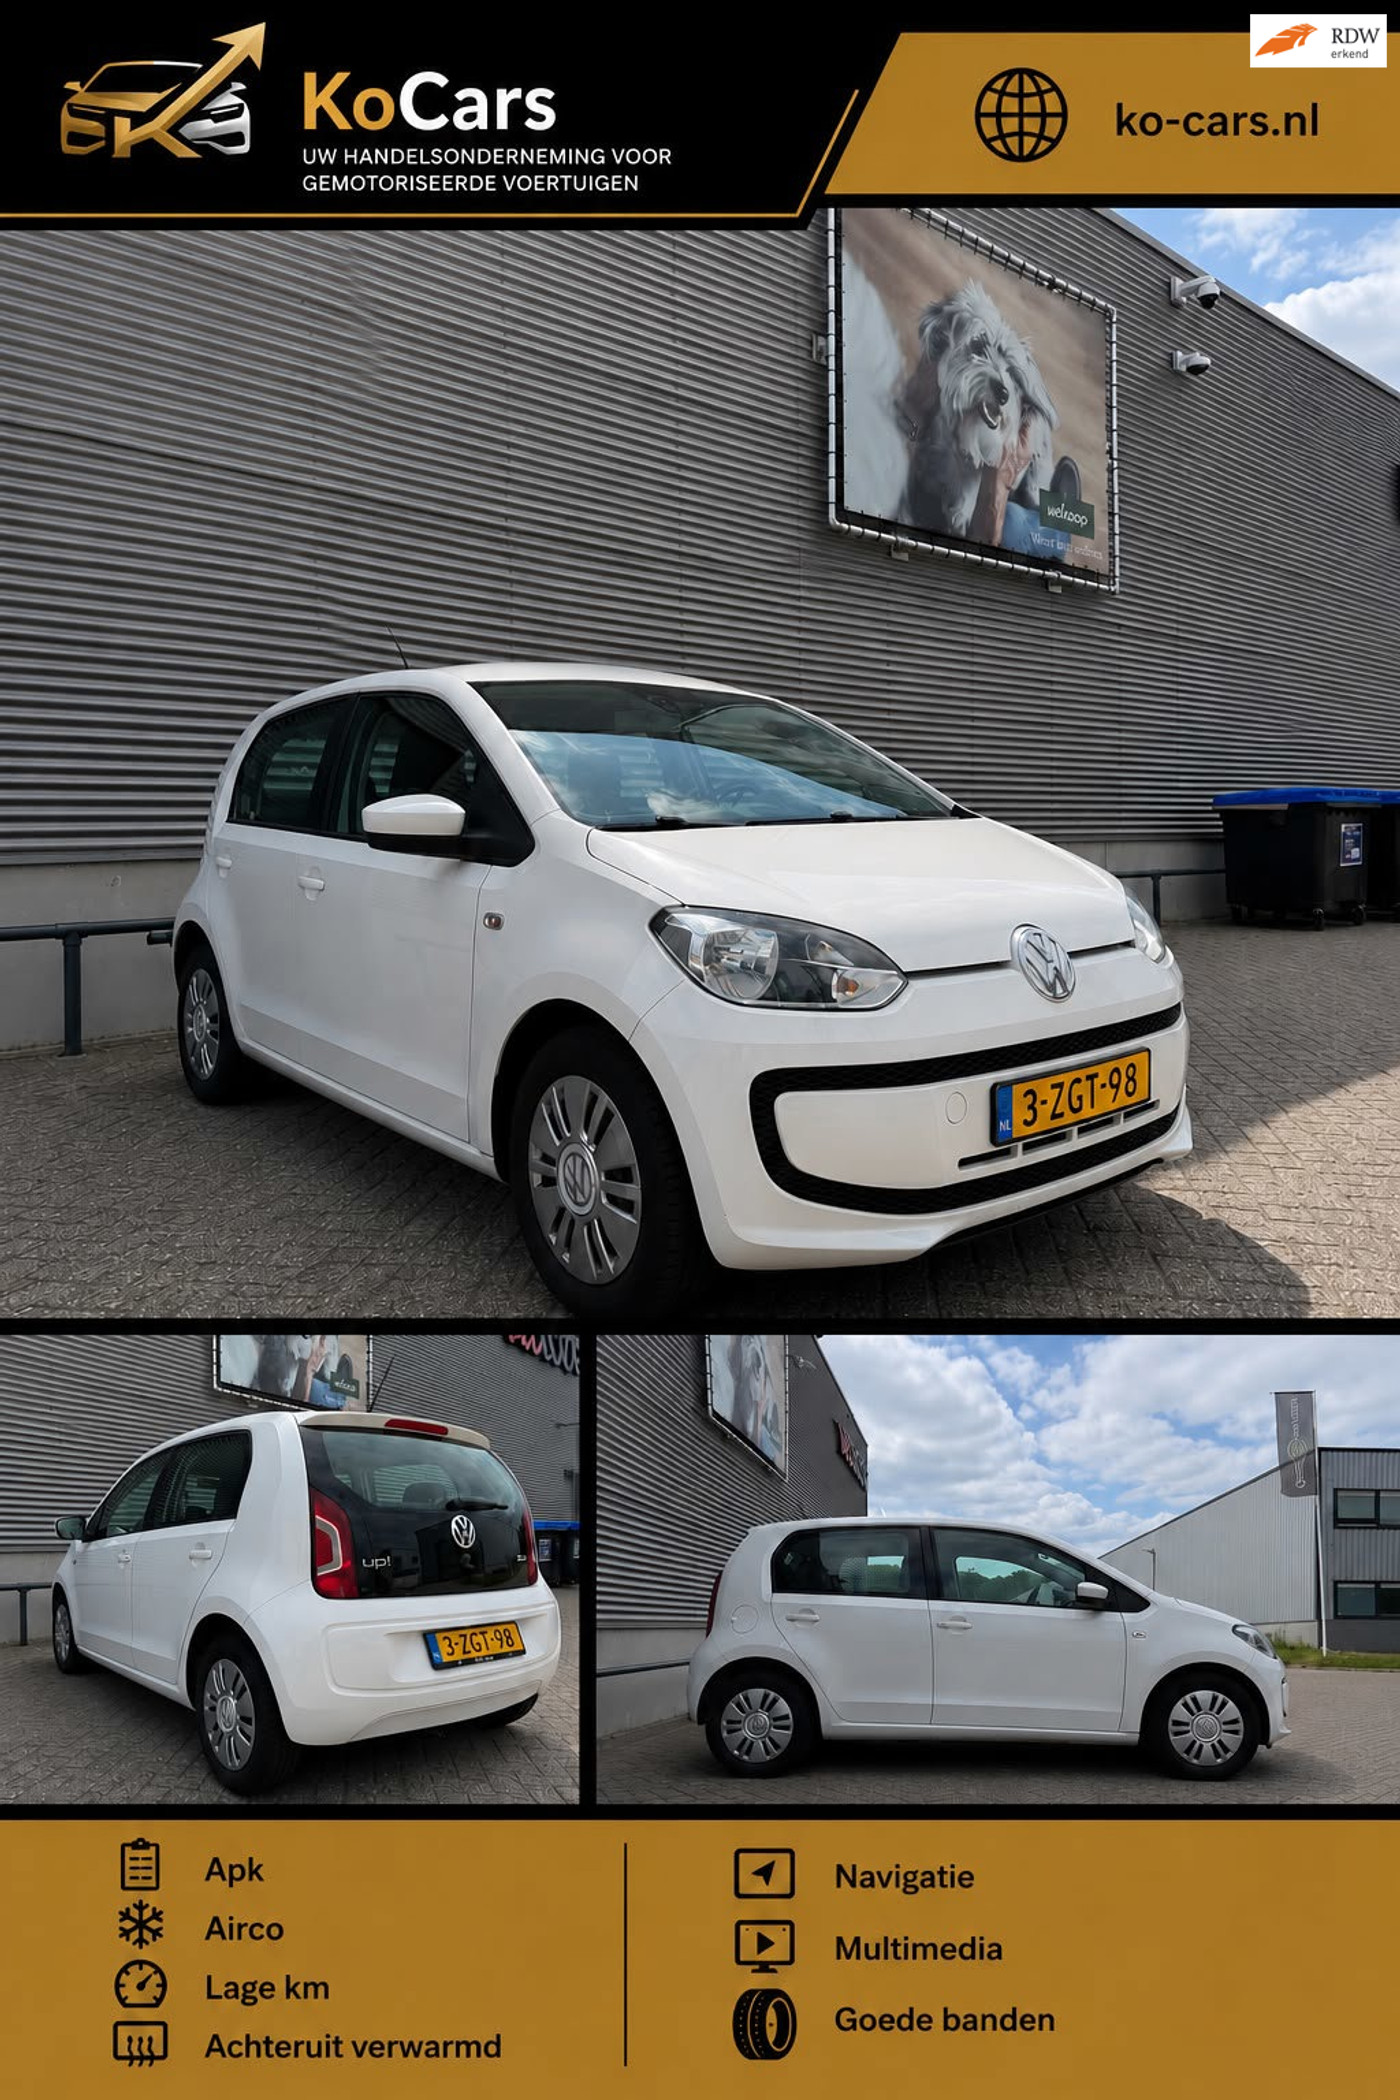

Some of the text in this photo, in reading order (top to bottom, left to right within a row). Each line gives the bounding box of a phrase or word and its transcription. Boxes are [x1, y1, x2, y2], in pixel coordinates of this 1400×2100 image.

[1022, 1062, 1138, 1128] 3-ZGT-98
[999, 1119, 1012, 1131] NL
[362, 1555, 392, 1570] up!
[442, 1628, 515, 1656] 3-ZGT-98
